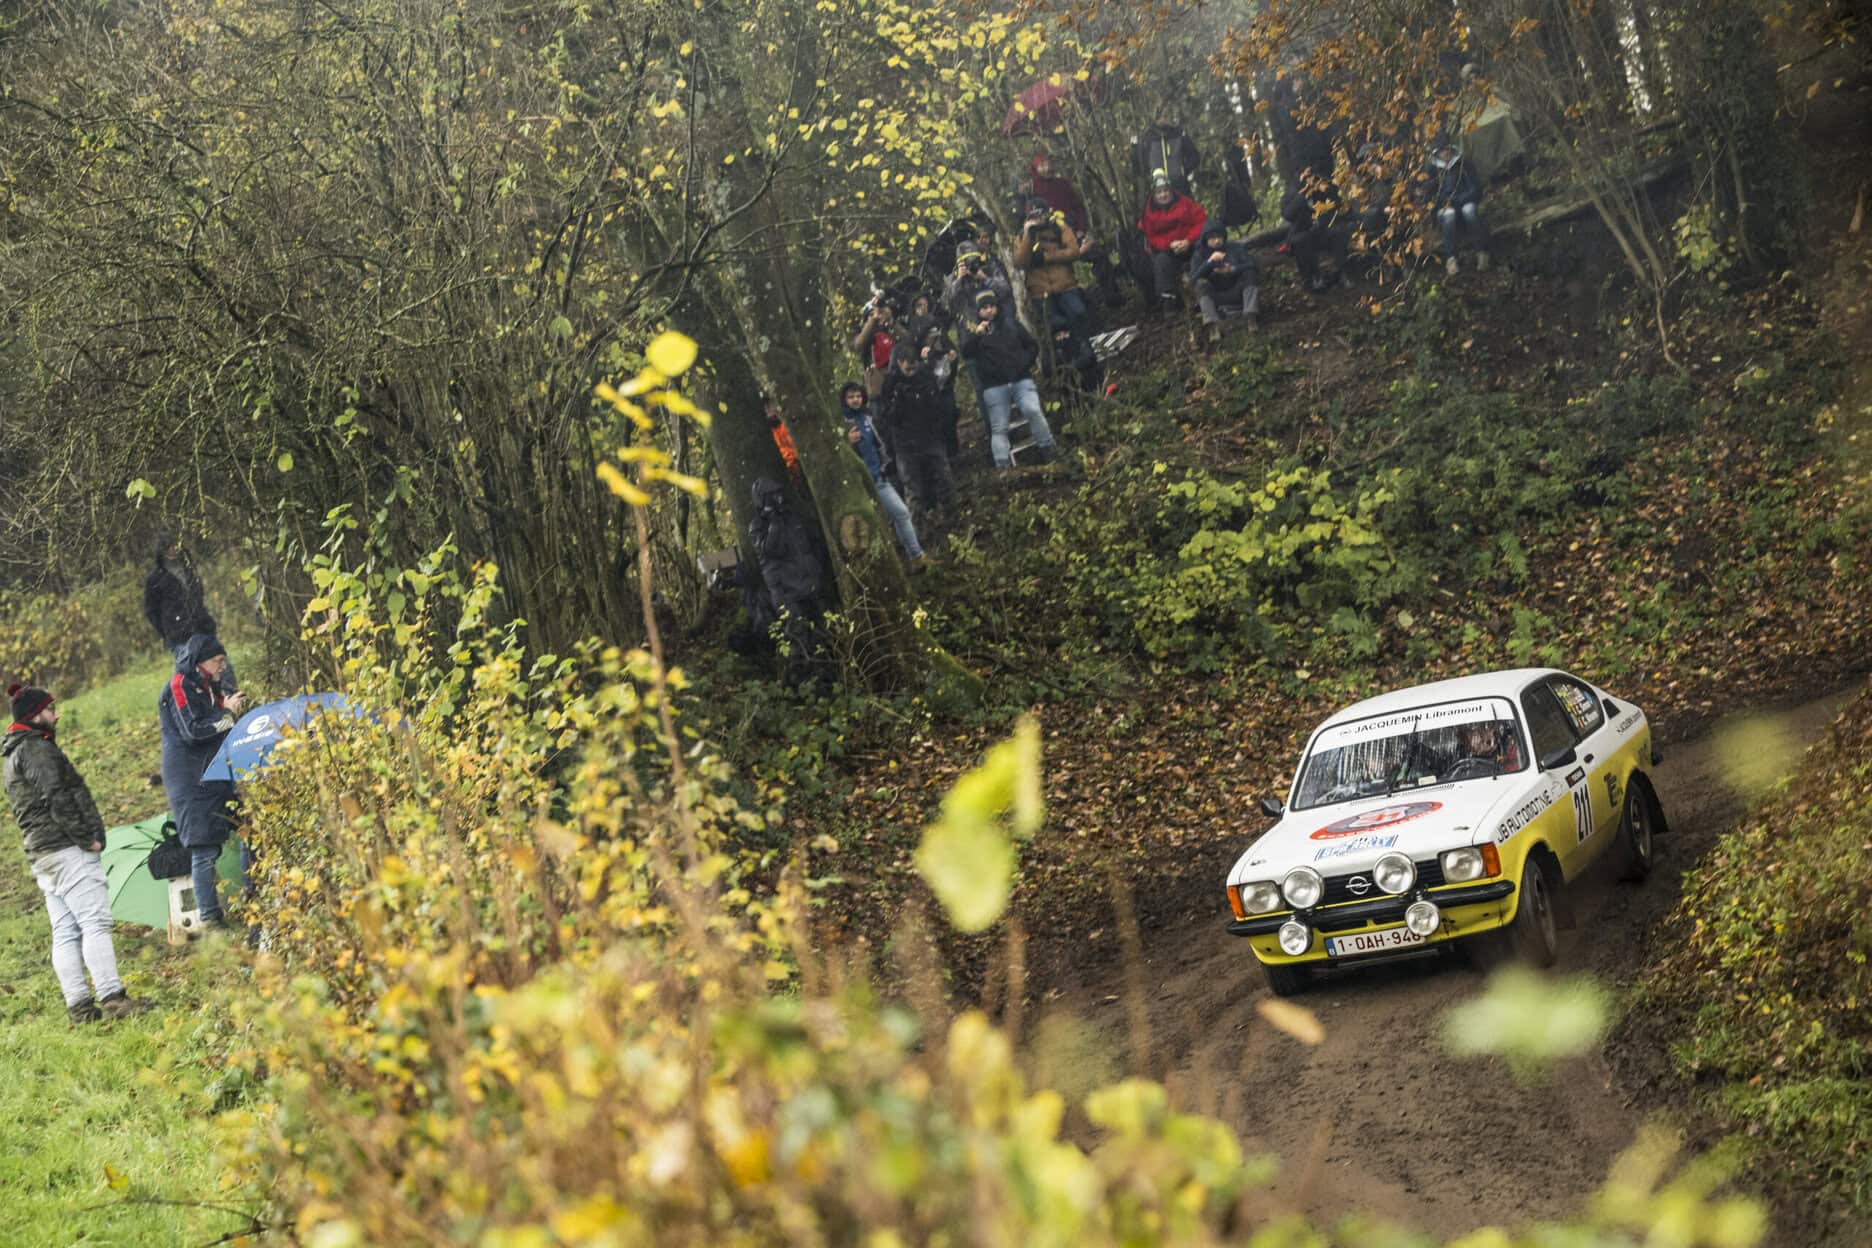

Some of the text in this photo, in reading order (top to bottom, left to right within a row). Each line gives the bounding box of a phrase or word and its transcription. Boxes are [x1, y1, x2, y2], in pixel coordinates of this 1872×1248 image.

[1354, 705, 1483, 735] JACQUEMIN Libramont
[1573, 783, 1593, 842] 211
